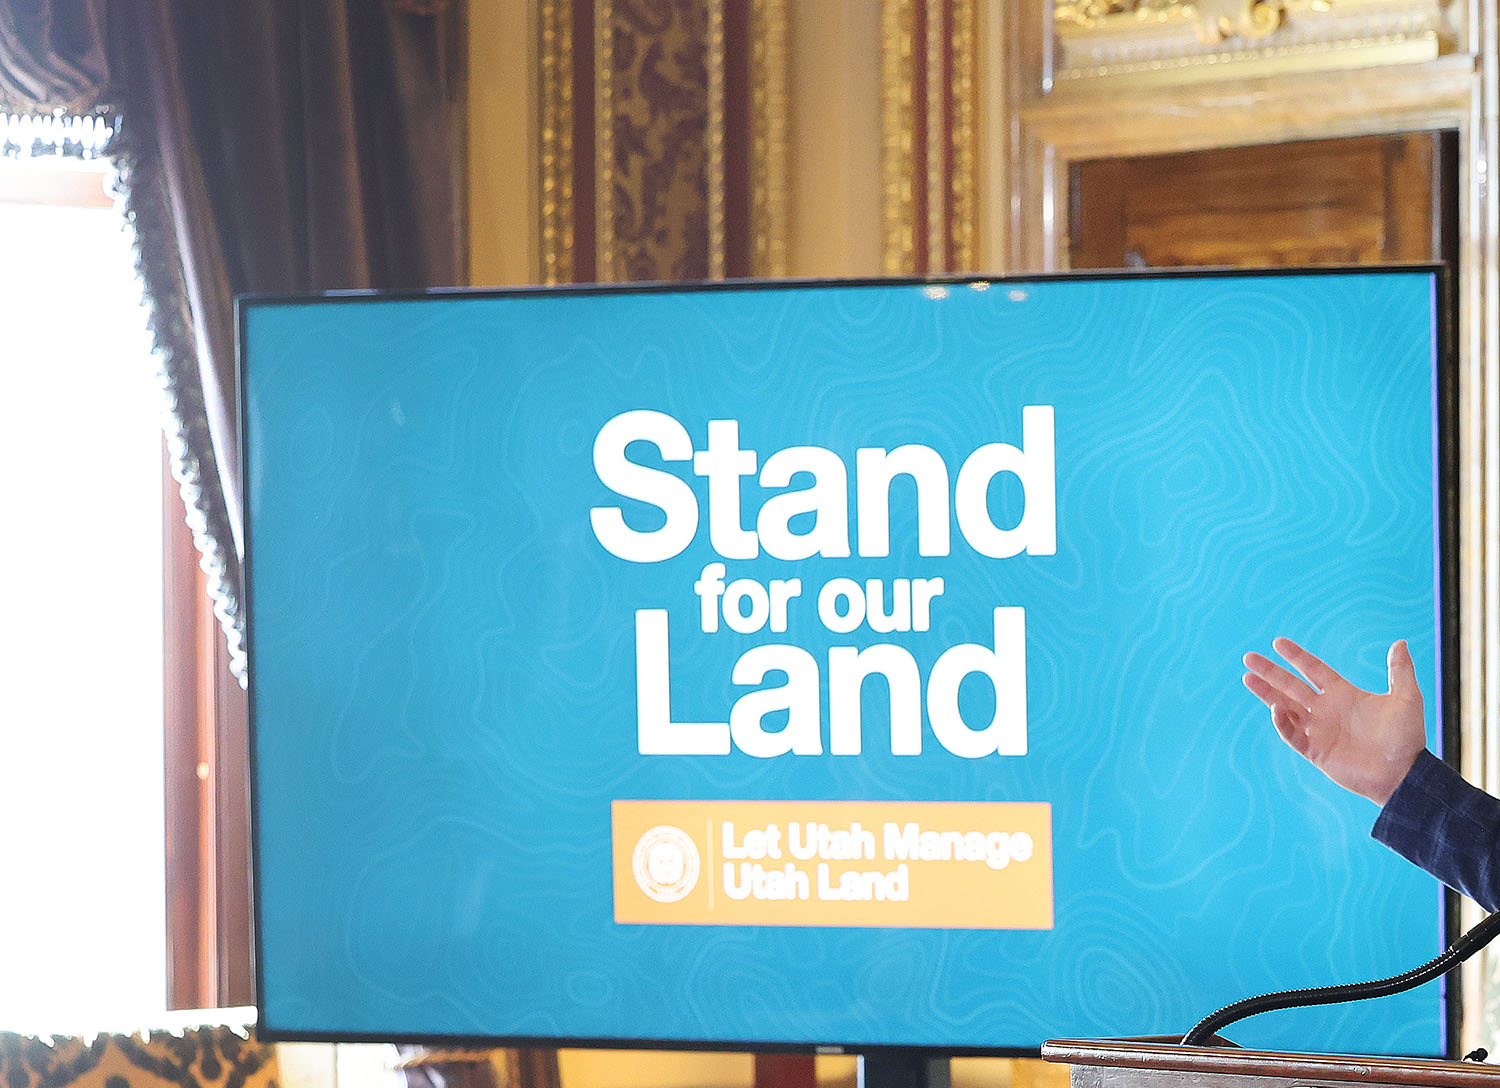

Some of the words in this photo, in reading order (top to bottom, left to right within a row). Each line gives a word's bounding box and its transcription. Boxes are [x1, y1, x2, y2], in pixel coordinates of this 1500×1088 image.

[591, 405, 1057, 563] Stand
[695, 563, 802, 633] for
[819, 577, 944, 633] our
[636, 606, 1028, 758] Land
[722, 821, 782, 860] Let
[788, 822, 876, 860] Utah
[883, 823, 1033, 870] Manage
[722, 862, 810, 900] Utah
[817, 864, 909, 901] Land
